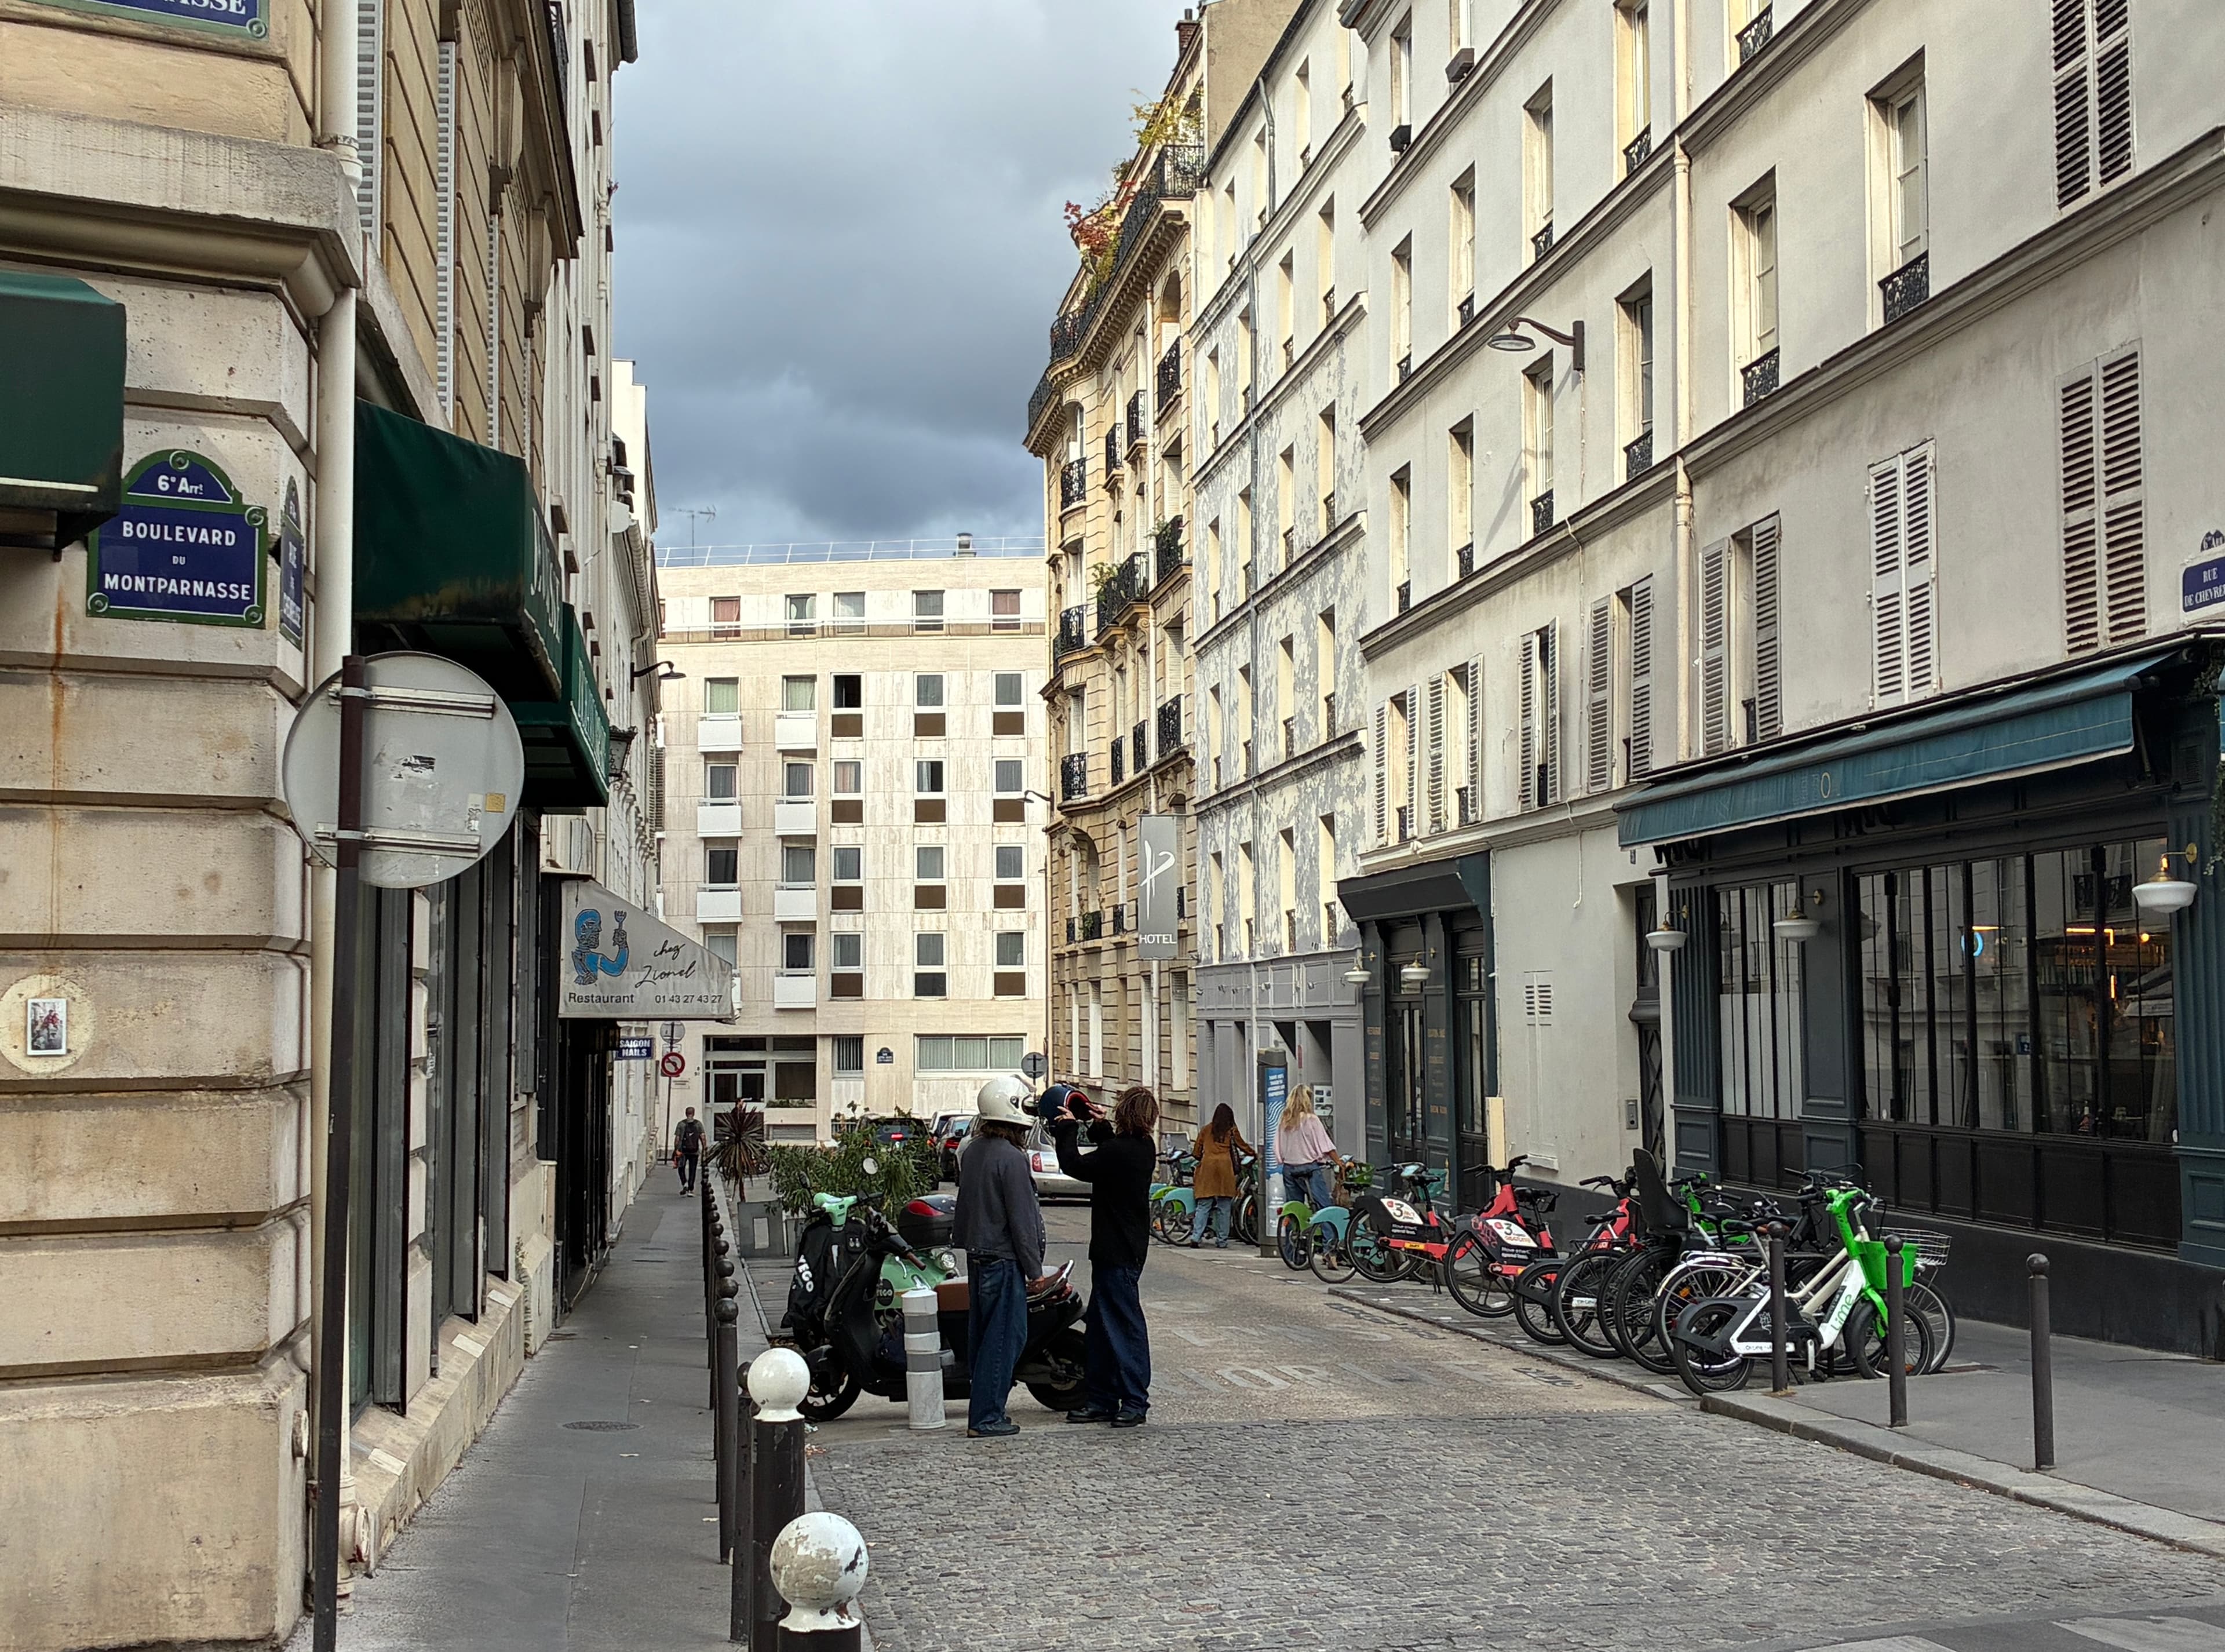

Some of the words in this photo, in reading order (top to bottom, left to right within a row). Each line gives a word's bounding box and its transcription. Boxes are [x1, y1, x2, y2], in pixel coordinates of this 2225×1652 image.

[122, 520, 236, 546] BOULEVARD
[172, 556, 186, 566] DU
[2202, 567, 2218, 583] RUE
[104, 573, 251, 600] MONTPARNASSE
[2184, 594, 2194, 607] DE
[1139, 933, 1177, 944] HOTEL
[568, 992, 634, 1004] Restaurant
[655, 994, 666, 1004] 01
[669, 994, 681, 1004] 43
[683, 994, 695, 1004] 27
[696, 994, 709, 1004] 43
[711, 994, 723, 1004] 27
[619, 1039, 650, 1048] SAIGON
[622, 1048, 647, 1057] NAILS
[1830, 1294, 1852, 1331] Lime
